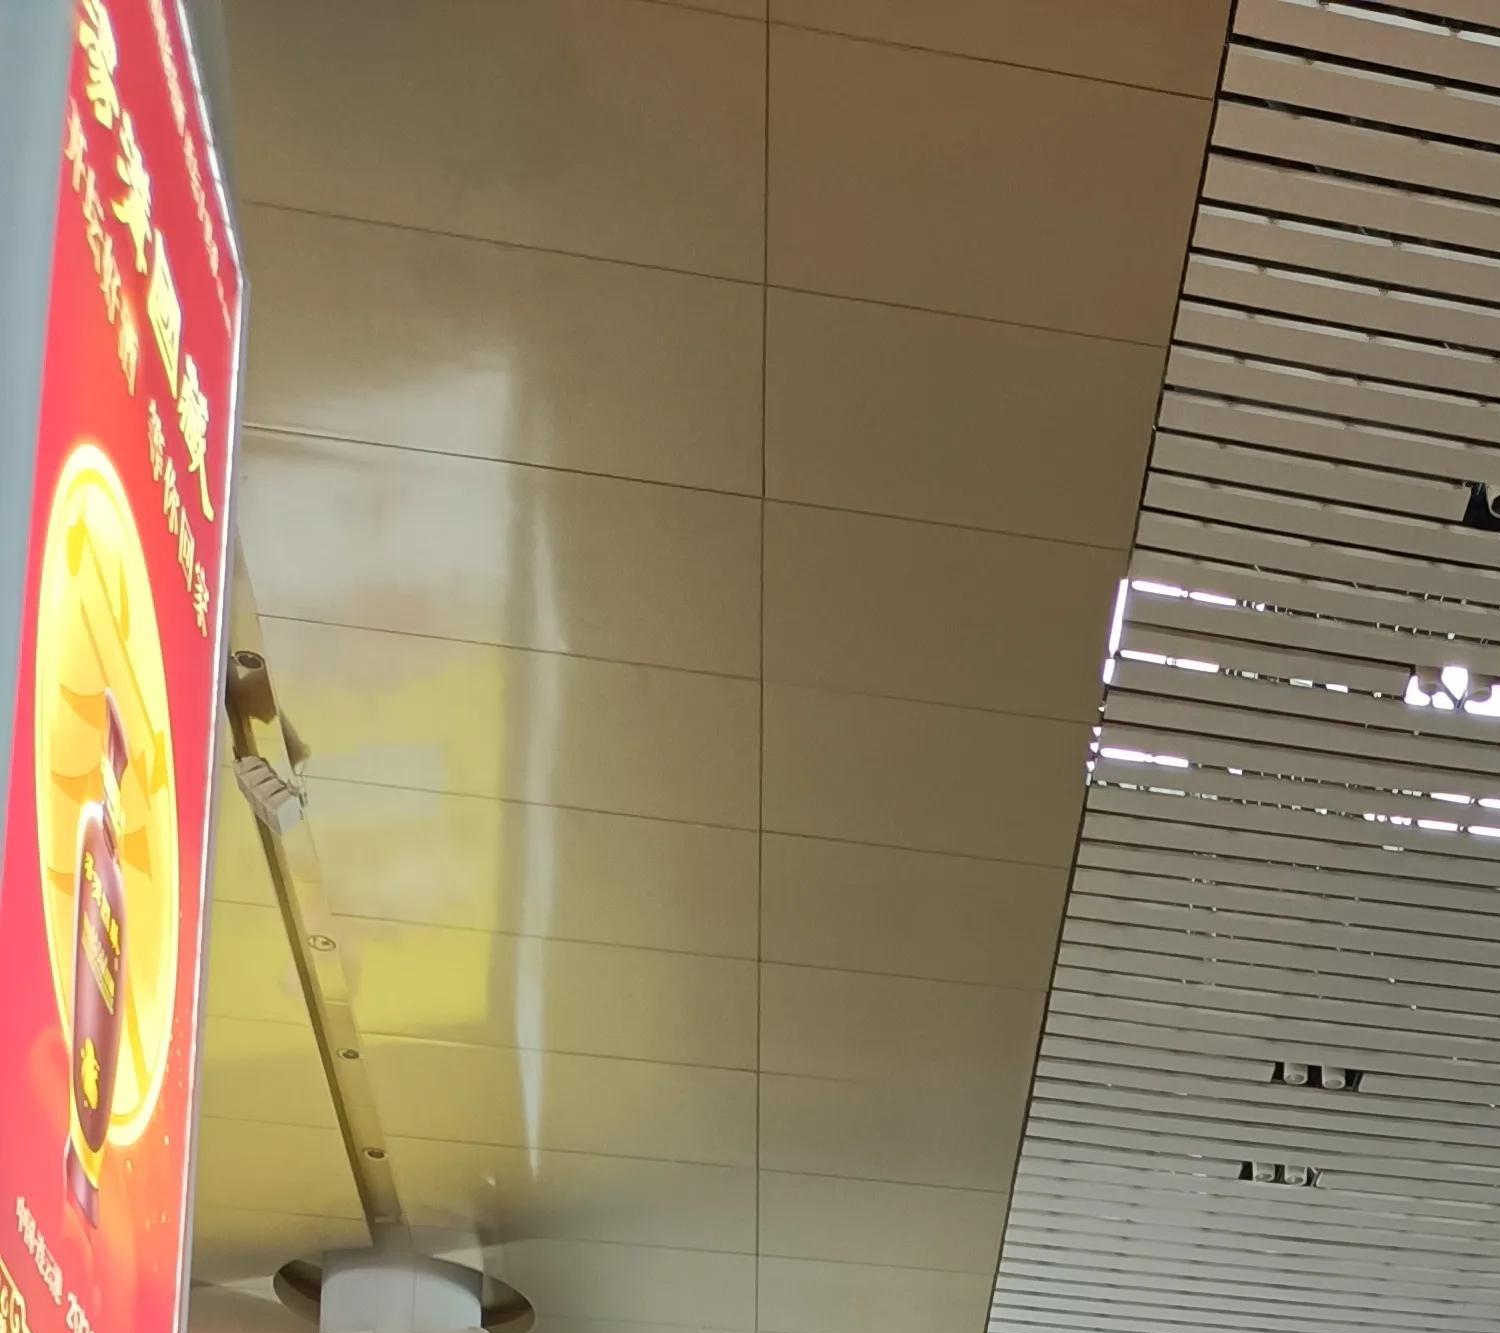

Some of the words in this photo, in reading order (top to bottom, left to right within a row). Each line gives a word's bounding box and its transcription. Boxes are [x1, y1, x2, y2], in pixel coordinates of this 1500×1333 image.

[64, 95, 139, 397] 开坛好酒
[147, 400, 210, 637] 等你回家
